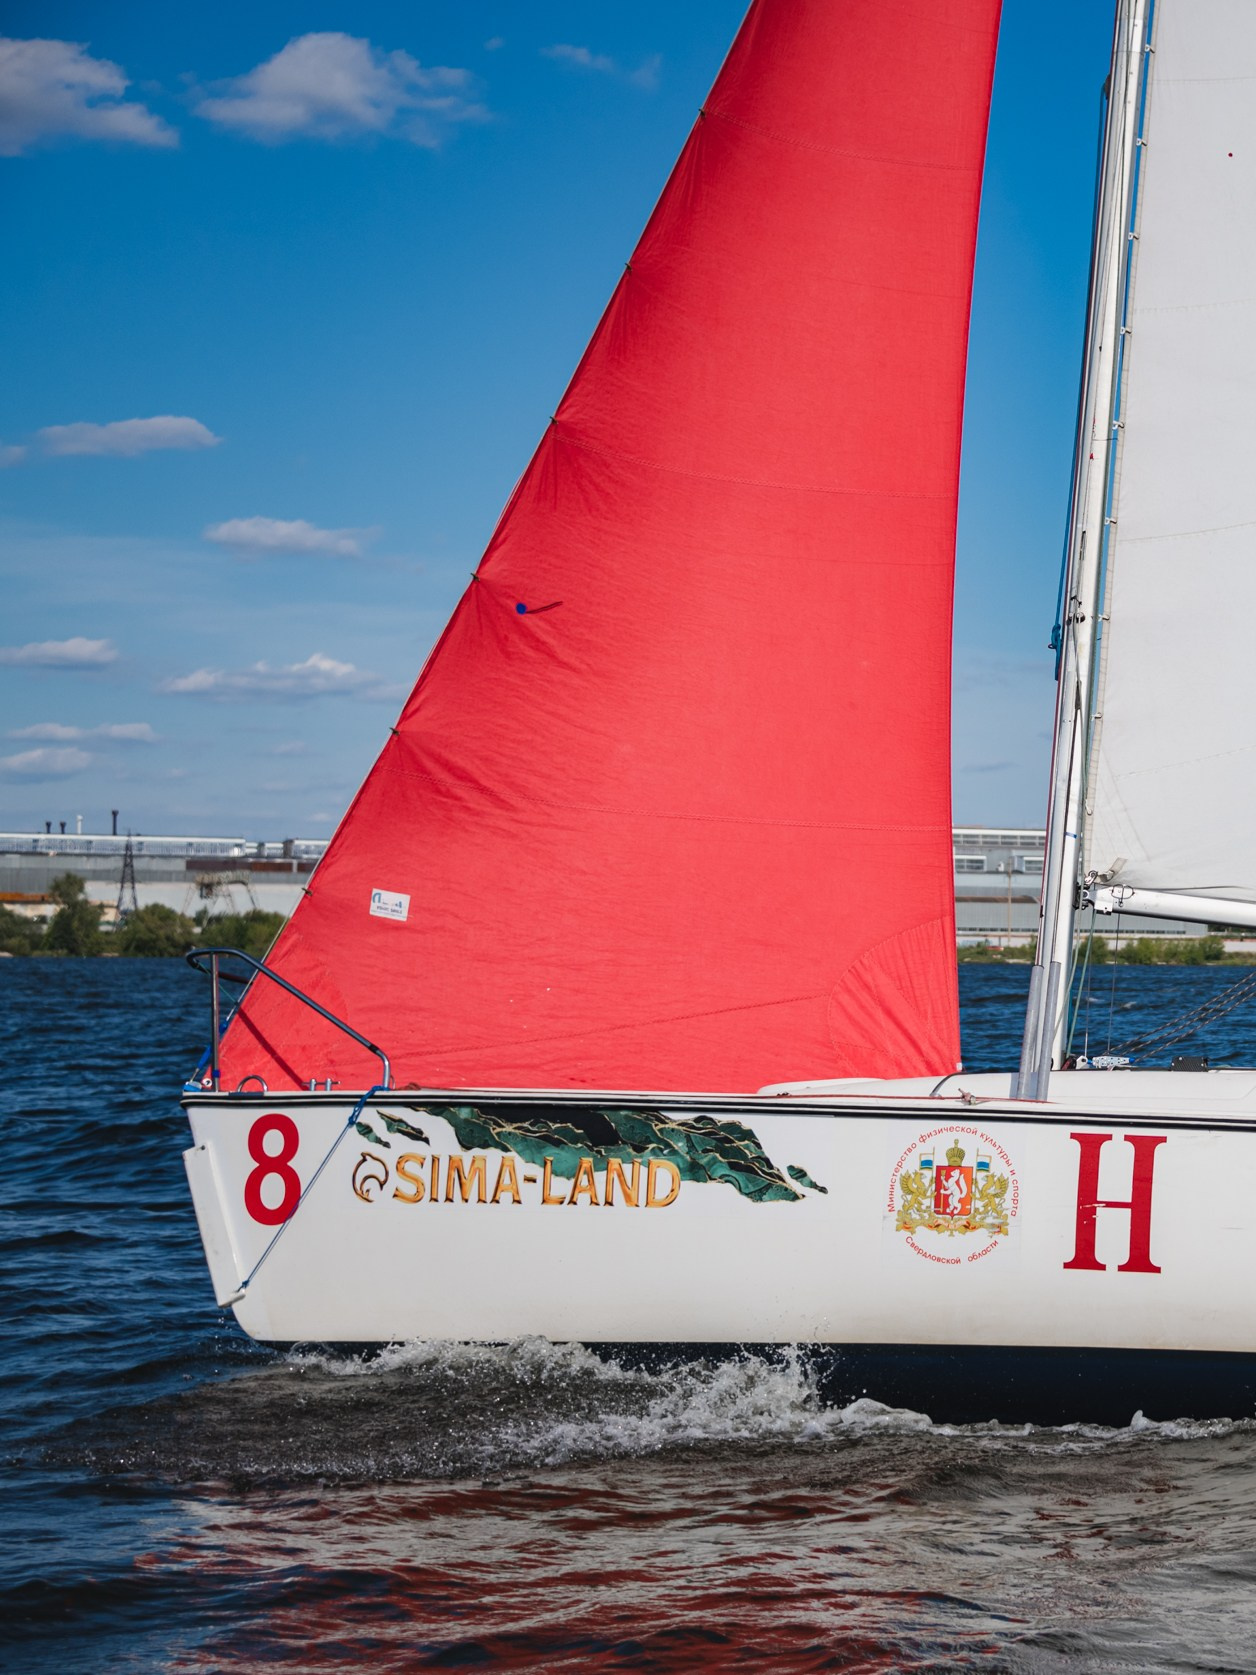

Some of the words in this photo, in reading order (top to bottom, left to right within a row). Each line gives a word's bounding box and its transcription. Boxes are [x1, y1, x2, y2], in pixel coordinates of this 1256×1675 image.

[244, 1113, 300, 1225] 8
[392, 1151, 682, 1208] SIMA-LAND
[887, 1142, 917, 1213] Министерство
[918, 1125, 978, 1144] физической
[979, 1132, 1013, 1168] культуры
[1010, 1179, 1020, 1217] спорта
[905, 1235, 961, 1265] Свердловской
[967, 1240, 998, 1263] области
